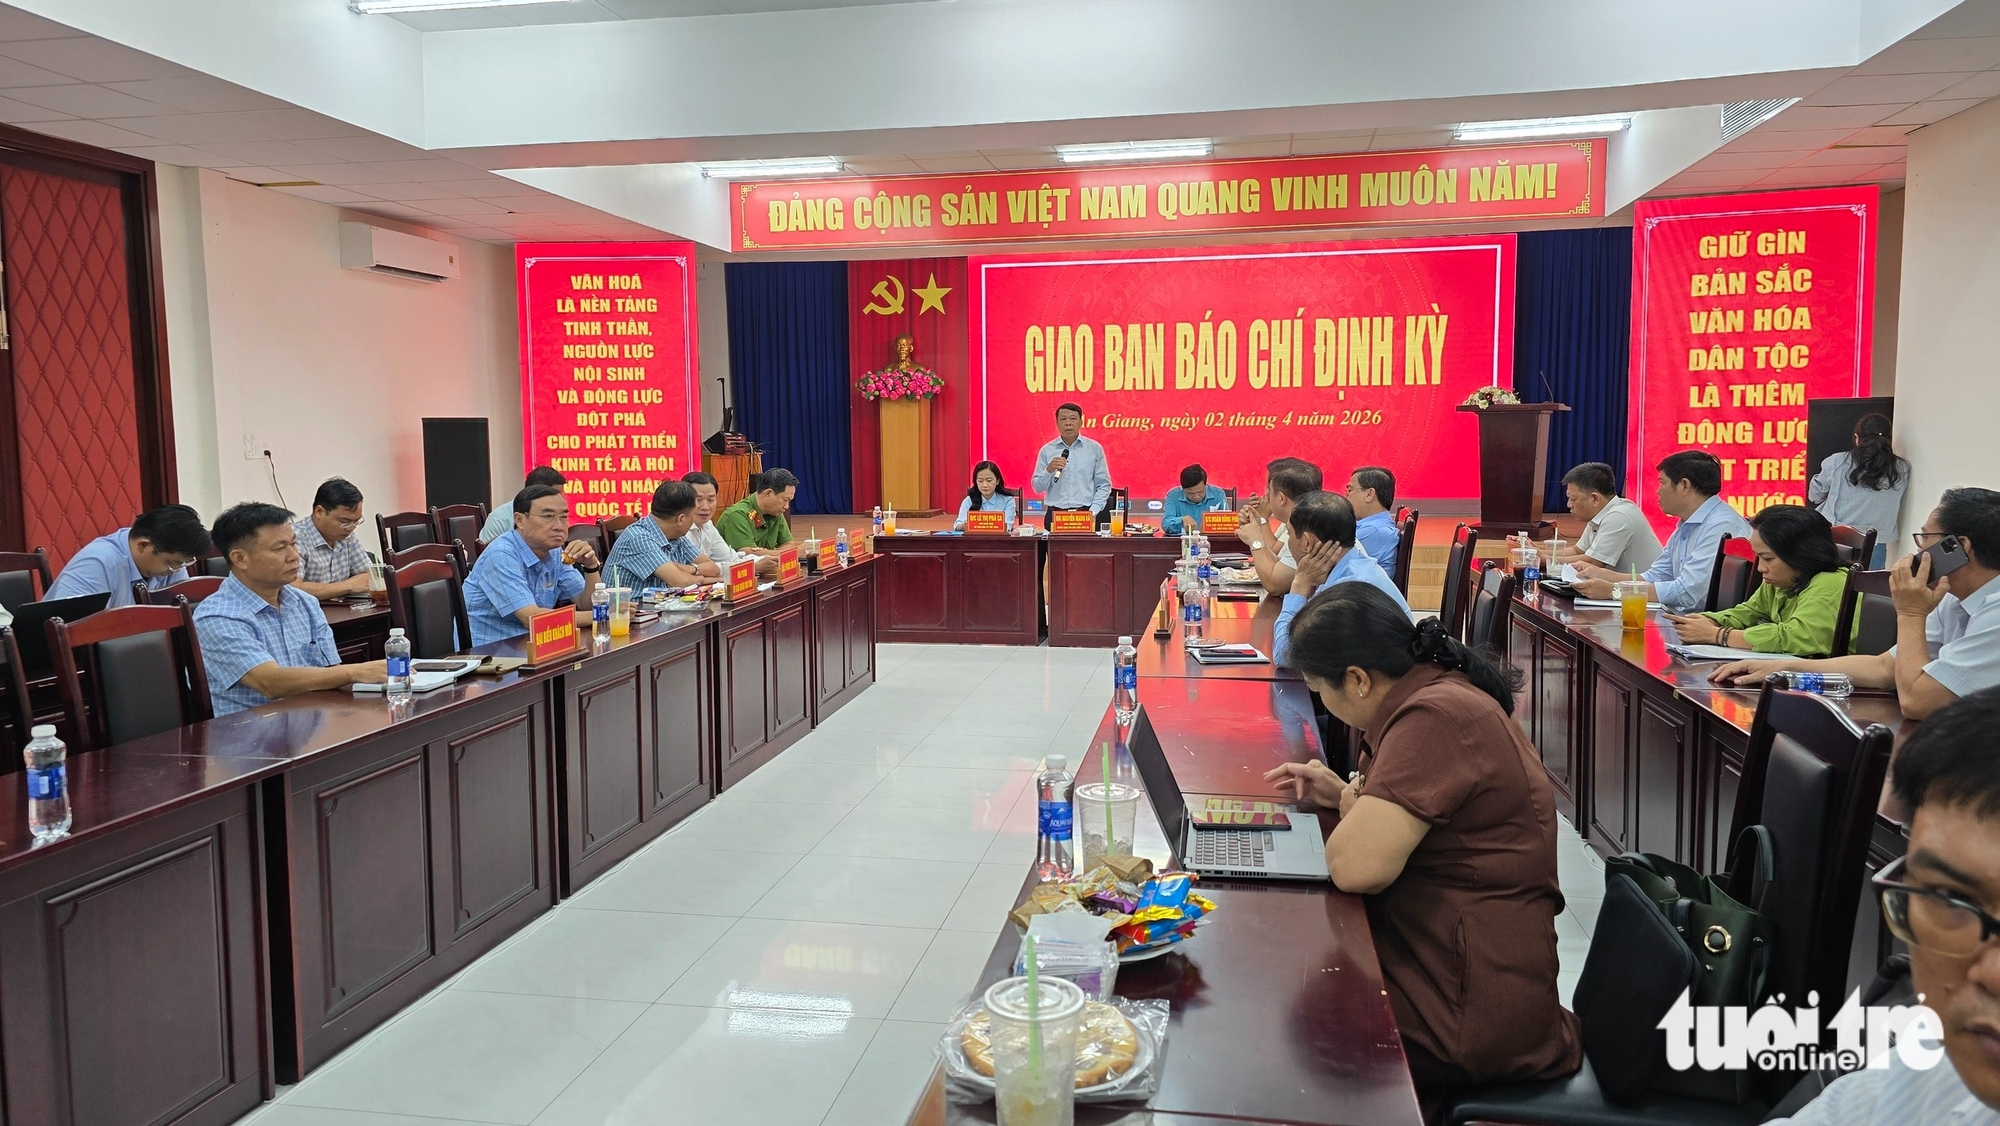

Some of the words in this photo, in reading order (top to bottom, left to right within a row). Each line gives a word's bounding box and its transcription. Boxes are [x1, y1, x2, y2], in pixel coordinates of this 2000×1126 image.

[768, 190, 844, 232] ĐẢNG
[853, 190, 932, 234] CỘNG
[940, 184, 998, 227] SẢN
[1006, 183, 1071, 229] VIỆT
[1080, 185, 1148, 221] NAM
[1157, 178, 1260, 221] QUANG
[1271, 173, 1348, 212] VINH
[1359, 163, 1457, 208] MUÔN
[1468, 158, 1558, 203] NĂM!
[1699, 230, 1751, 259] GIỮ
[1757, 228, 1807, 256] GÌN
[570, 274, 603, 290] VĂN
[608, 274, 642, 290] HOÁ
[1691, 267, 1746, 297] BẢN
[1756, 263, 1812, 293] SẮC
[556, 297, 575, 313] LÀ
[580, 295, 611, 313] NỀN
[616, 296, 658, 313] TẢNG
[563, 321, 601, 336] TINH
[606, 317, 653, 337] THẦN,
[1689, 307, 1744, 334] VĂN
[1753, 305, 1812, 331] HÓA
[563, 340, 619, 359] NGUỒN
[623, 343, 654, 360] LỰC
[1025, 324, 1094, 393] GIAO
[1104, 323, 1165, 391] BAN
[1175, 310, 1237, 390] BÁO
[1248, 307, 1305, 390] CHÍ
[1313, 316, 1394, 401] ĐỊNH
[1404, 303, 1449, 386] KỲ
[1688, 345, 1744, 371] DÂN
[1752, 342, 1809, 372] TỘC
[573, 365, 602, 383] NỘI
[606, 367, 645, 381] SINH
[557, 388, 579, 404] VÀ
[583, 387, 628, 406] ĐỘNG
[633, 388, 663, 405] LỰC
[1689, 382, 1721, 408] LÀ
[1728, 380, 1805, 407] THÊM
[577, 410, 609, 427] ĐỘT
[613, 411, 646, 426] PHÁ
[1102, 413, 1155, 431] Giang,
[1160, 412, 1200, 431] ngày
[1204, 412, 1224, 427] 02
[1228, 411, 1278, 431] tháng
[1282, 411, 1293, 426] 4
[1297, 411, 1335, 426] năm
[1340, 409, 1382, 426] 2026
[546, 435, 580, 449] CHO
[585, 434, 627, 449] PHÁT
[631, 430, 677, 449] TRIỂN
[1677, 418, 1753, 448] ĐỘNG
[551, 457, 590, 471] KINH
[594, 455, 617, 472] TẾ,
[621, 455, 642, 471] XÃ
[645, 456, 674, 473] HỘI
[1744, 450, 1807, 481] TRIỂ
[563, 478, 585, 494] VÀ
[588, 477, 617, 496] HỘI
[575, 498, 620, 518] QUỐC
[623, 498, 643, 516] TẾ
